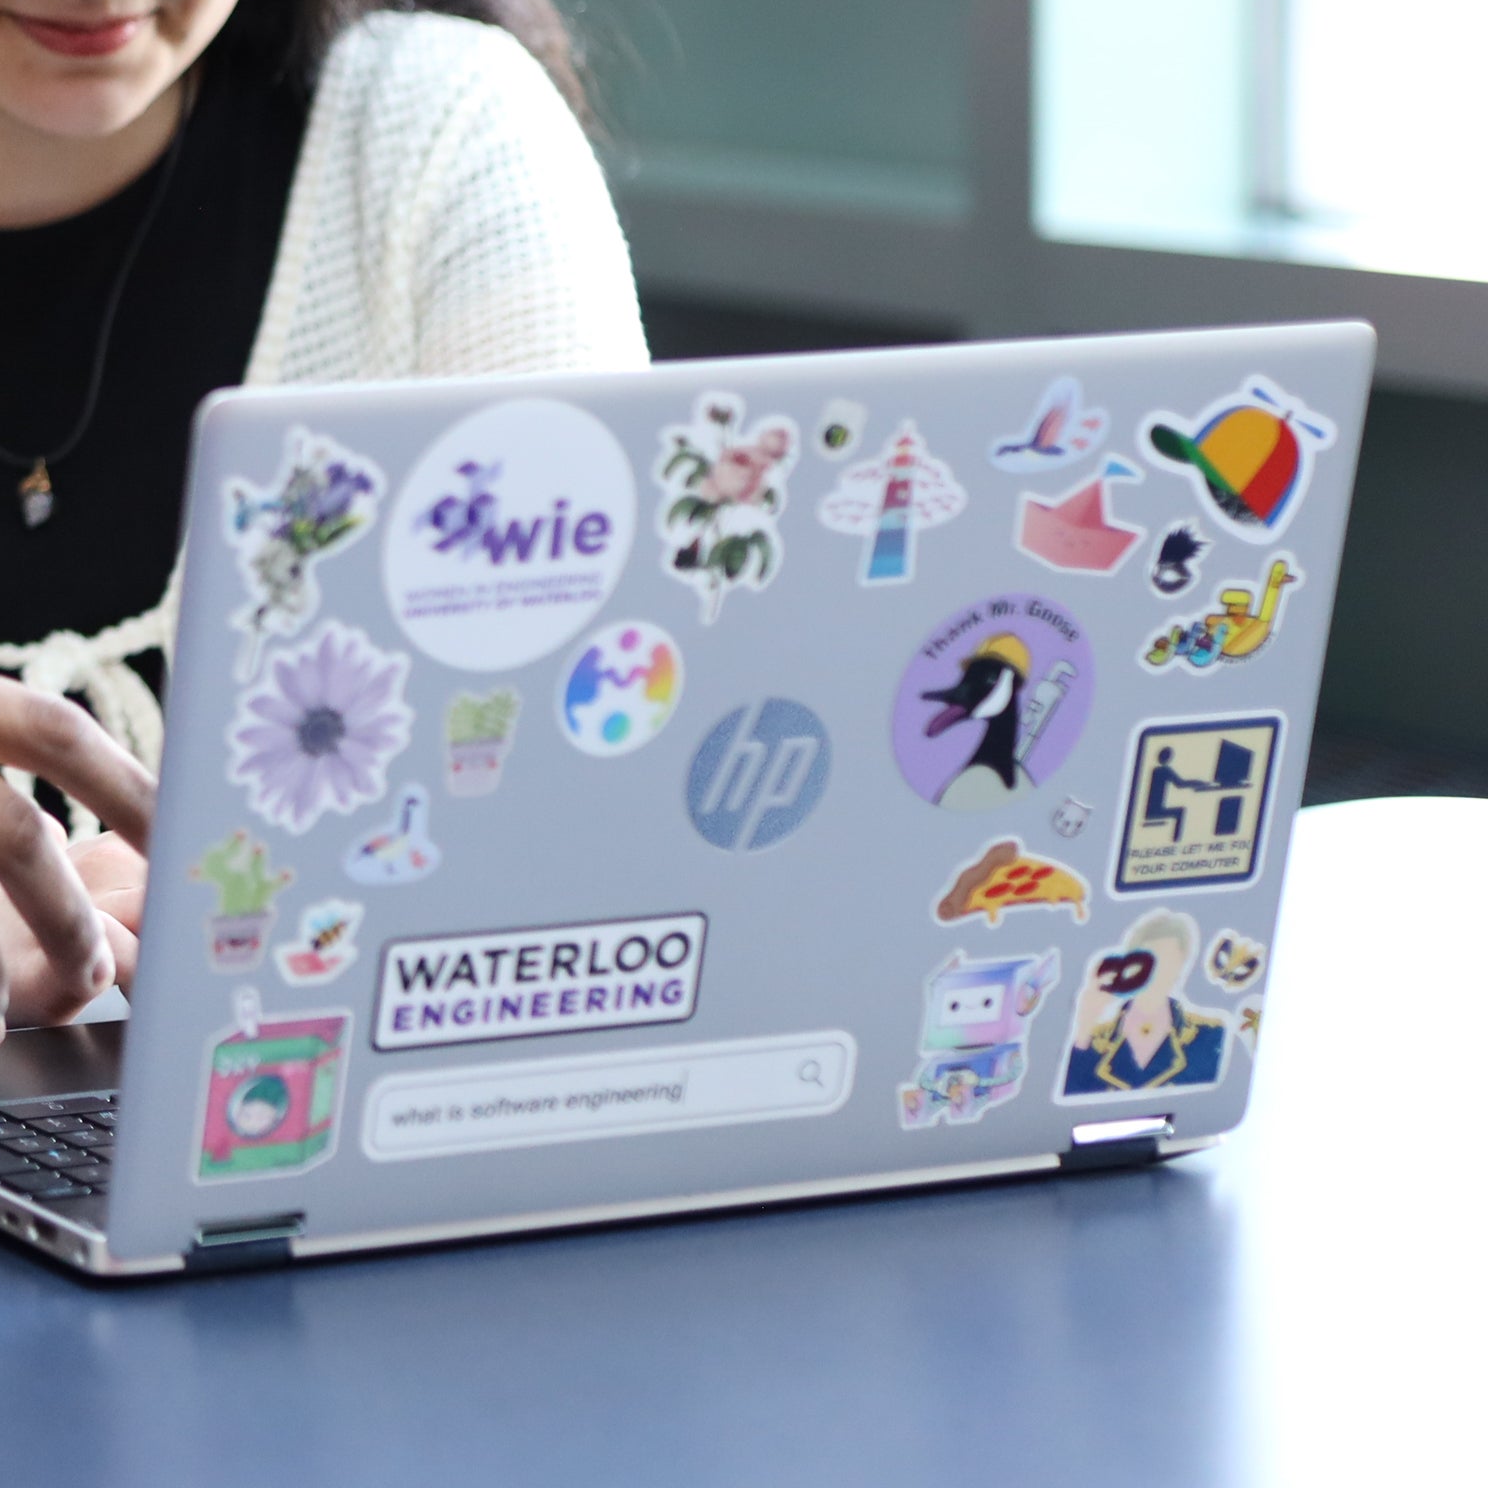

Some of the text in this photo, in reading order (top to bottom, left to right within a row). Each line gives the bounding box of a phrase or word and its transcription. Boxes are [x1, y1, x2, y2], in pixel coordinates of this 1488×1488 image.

[481, 497, 612, 565] wie
[698, 695, 821, 853] hp
[1133, 857, 1241, 876] YOUR COMPUTER
[395, 931, 692, 994] WATERLOO
[391, 978, 685, 1033] ENGINEERING
[391, 1082, 684, 1128] what is software engineering
